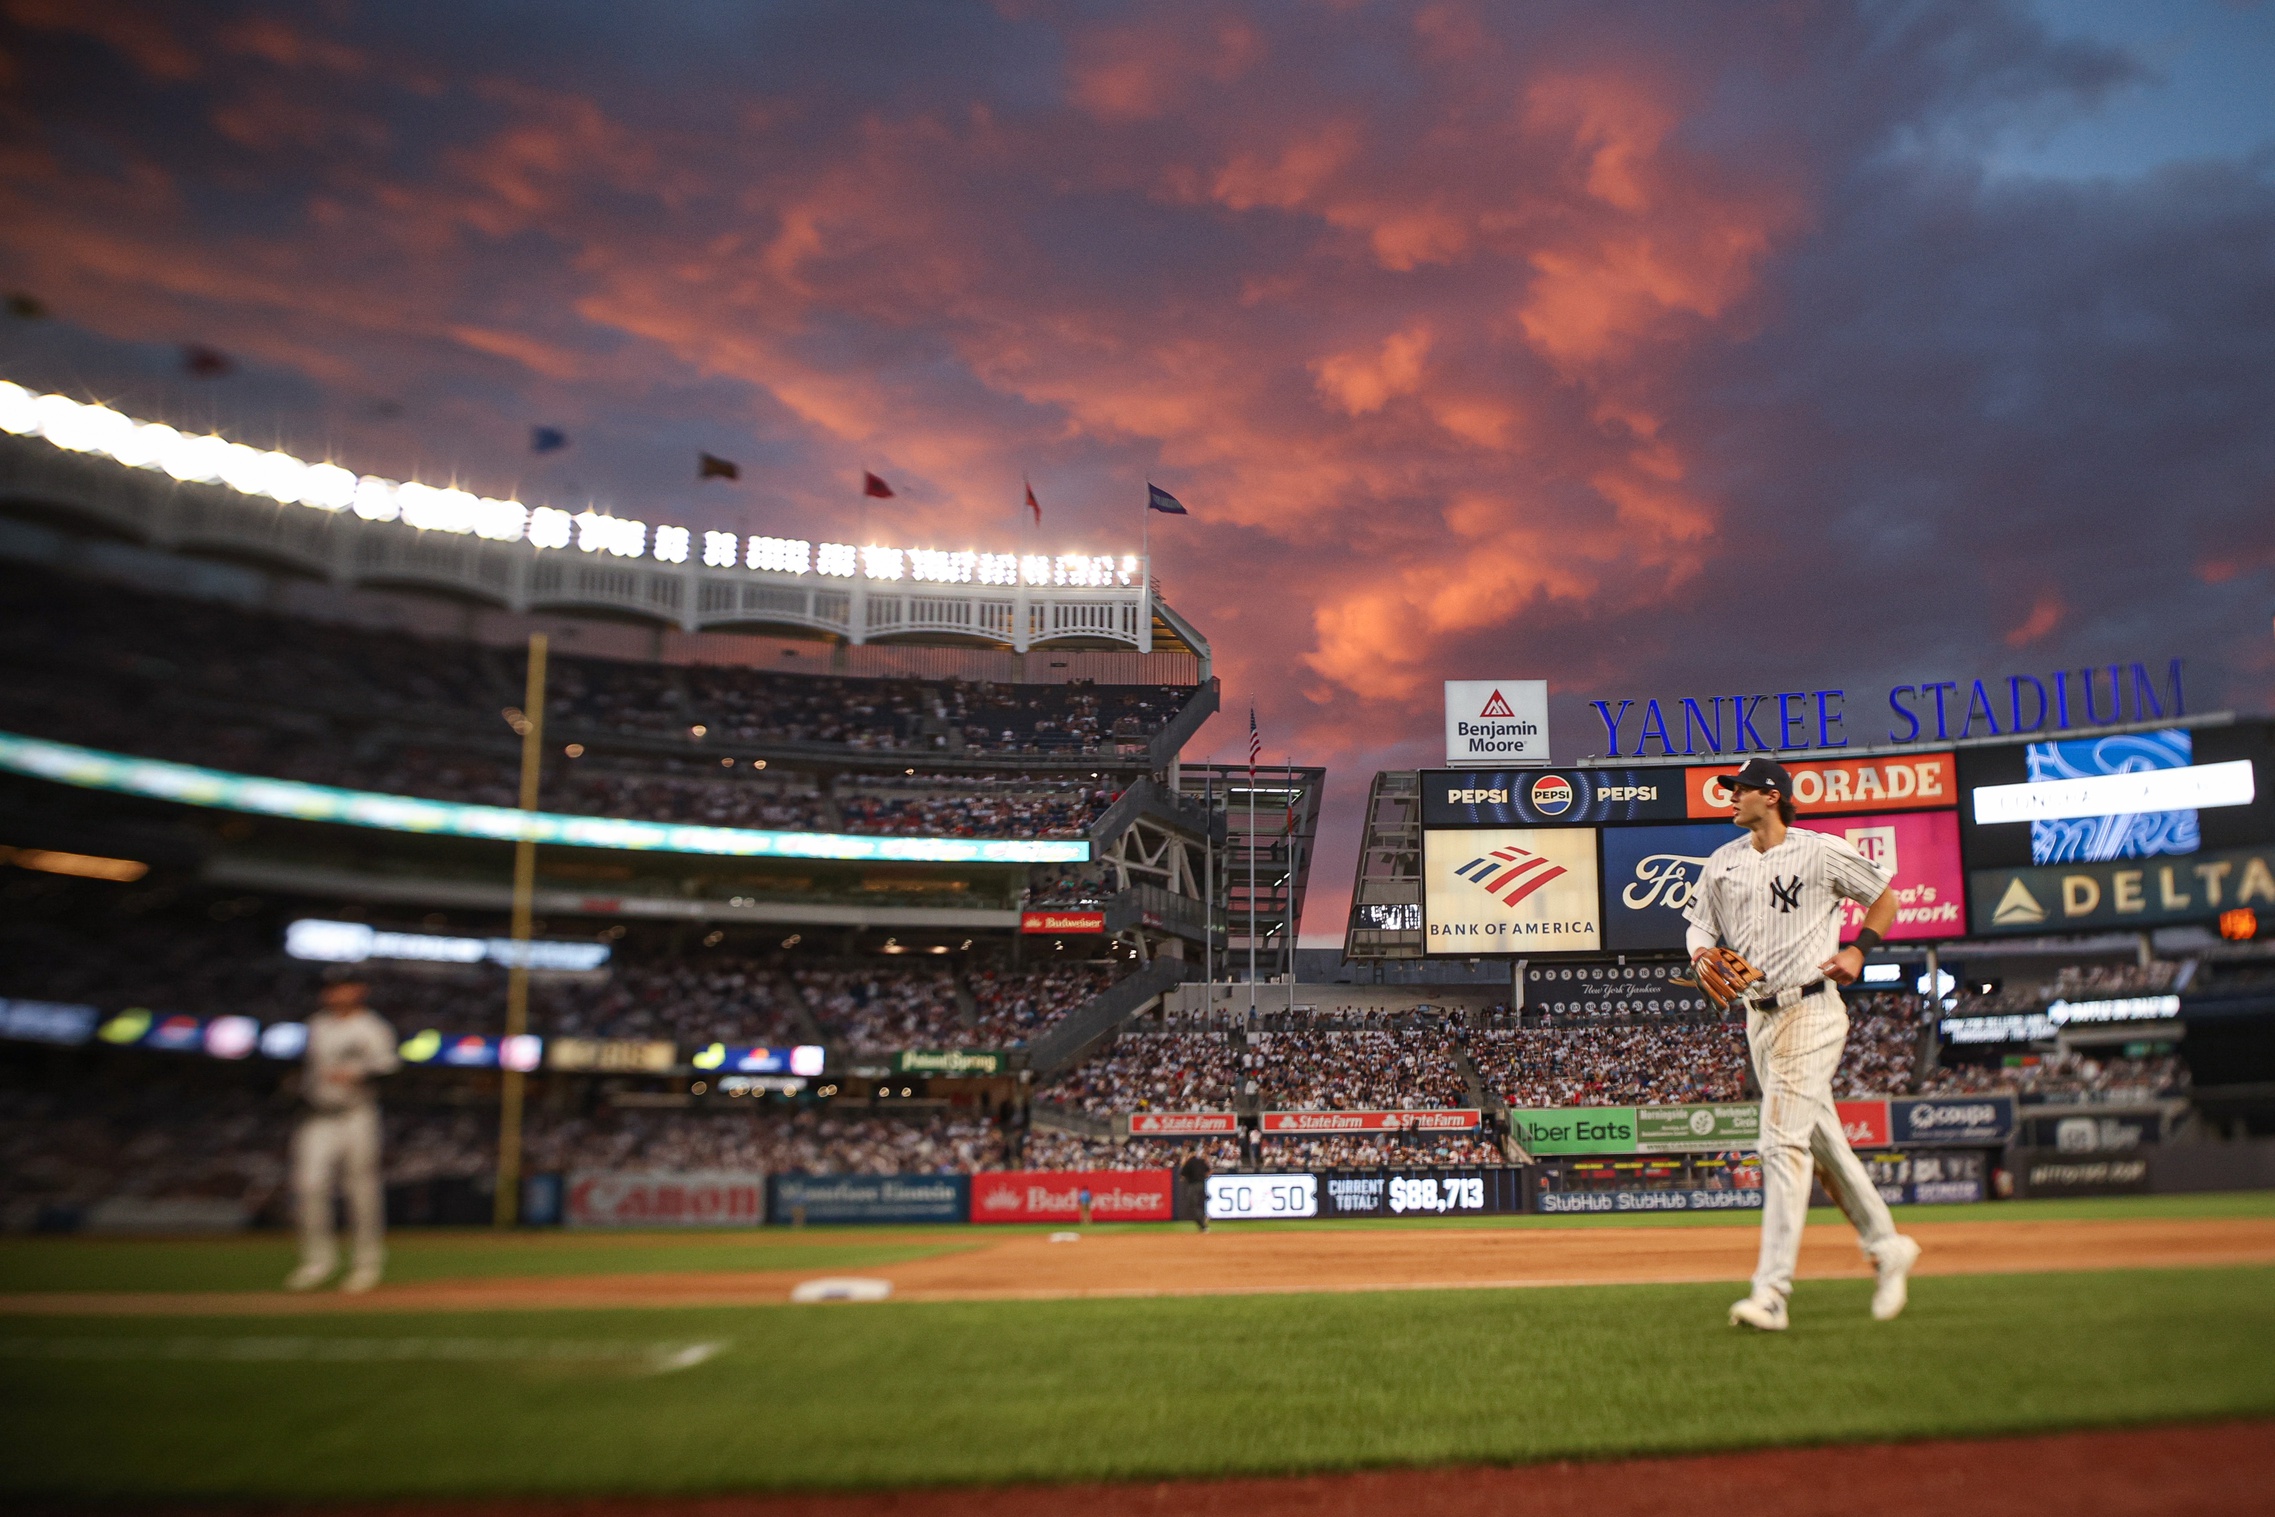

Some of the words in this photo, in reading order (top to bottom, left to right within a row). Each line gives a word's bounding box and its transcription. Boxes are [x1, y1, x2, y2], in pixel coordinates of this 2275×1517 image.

[1590, 689, 1848, 758] YANKEE
[1888, 657, 2186, 744] STADIUM
[1458, 720, 1538, 739] Benjamin
[1468, 738, 1524, 752] Moore
[1597, 786, 1658, 802] PEPSI
[1702, 762, 1943, 808] GORADE
[1448, 789, 1508, 804] PEPSI
[1534, 790, 1571, 800] PEPSI
[1622, 854, 1710, 910] Fo
[2061, 858, 2275, 918] DELTA
[1770, 875, 1804, 913] NY
[1045, 916, 1102, 929] Budweiser
[1430, 923, 1479, 935] BANK
[1484, 923, 1507, 935] OF
[1511, 921, 1595, 935] AMERICA
[1582, 983, 1603, 994] New
[1603, 983, 1625, 999] York
[1625, 983, 1662, 999] Yankees
[1576, 1121, 1631, 1141] Eats
[1327, 1179, 1386, 1196] CURRENT
[1388, 1176, 1485, 1214] $88,713
[569, 1179, 757, 1217] Canon
[1027, 1186, 1163, 1213] Budeiser
[1218, 1187, 1252, 1212] 50
[1272, 1186, 1304, 1211] 50
[1543, 1193, 1613, 1211] StubHub
[1618, 1191, 1687, 1210] StubHub
[1690, 1190, 1762, 1208] StubHub
